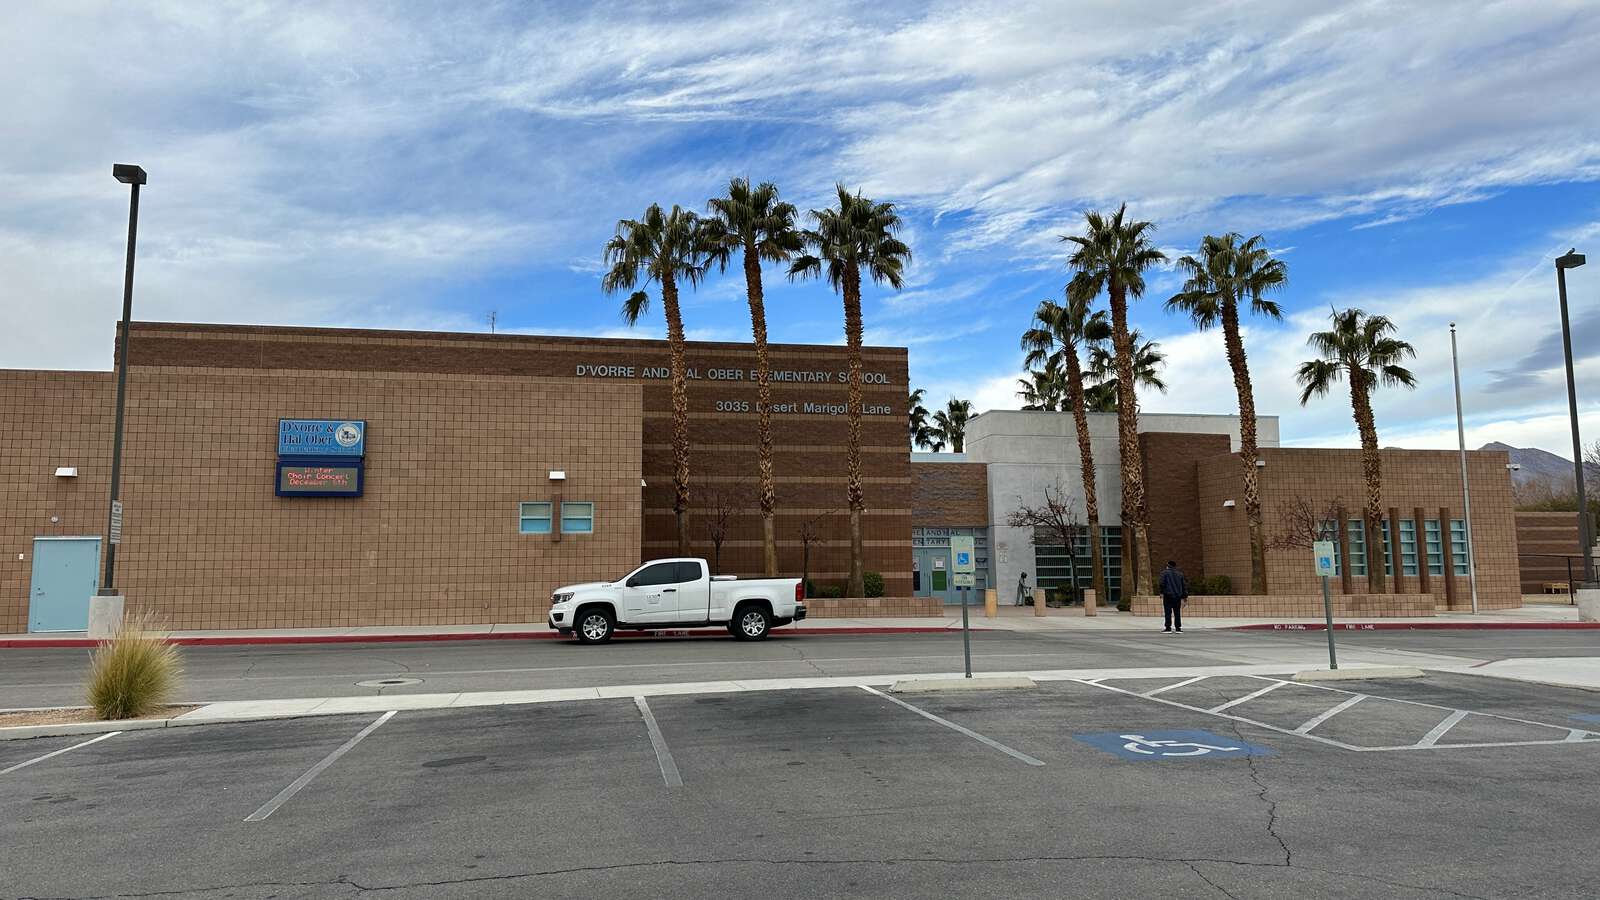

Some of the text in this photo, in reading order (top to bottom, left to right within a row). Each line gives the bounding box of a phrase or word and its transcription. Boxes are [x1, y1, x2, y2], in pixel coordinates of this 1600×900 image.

[576, 365, 635, 377] D'VORRE
[641, 367, 670, 378] AND
[707, 369, 743, 380] OBER
[750, 370, 831, 382] EEMENTARY
[715, 401, 891, 416] 3035 Dsert Marigol Lane
[326, 423, 334, 433] &
[282, 434, 333, 445] Hal Ober
[287, 472, 312, 480] Choir
